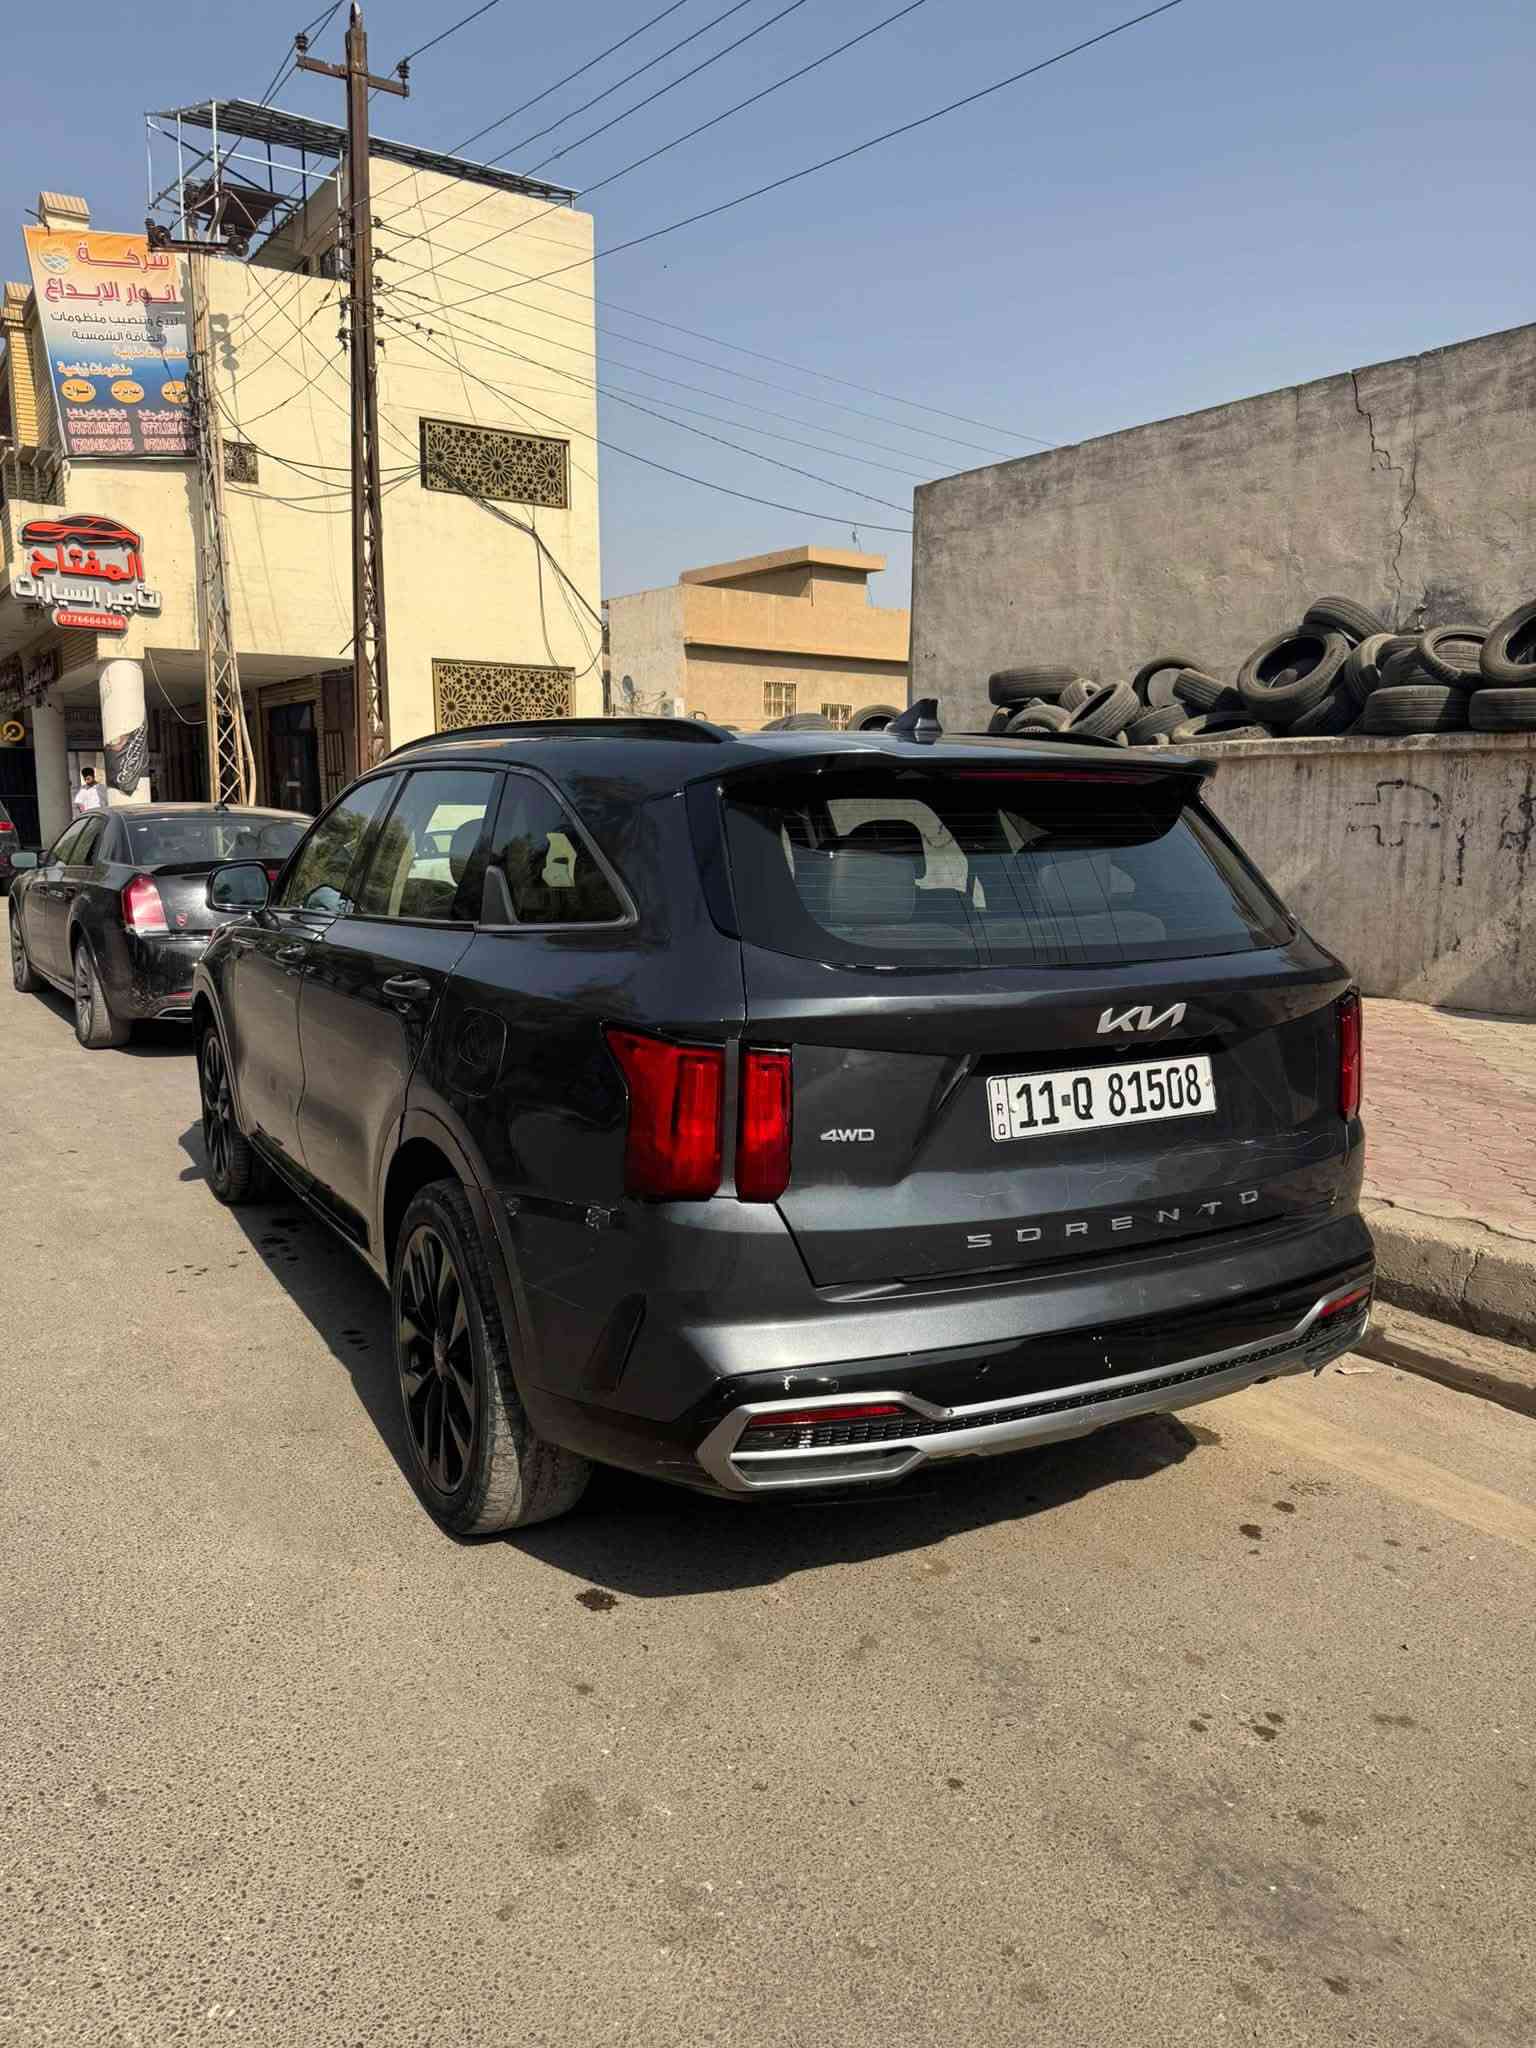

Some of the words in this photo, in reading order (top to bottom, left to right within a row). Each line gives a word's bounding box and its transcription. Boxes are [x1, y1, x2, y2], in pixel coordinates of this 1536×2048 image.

[31, 543, 145, 583] المفتاح
[16, 575, 100, 608] السيارات
[1107, 1063, 1201, 1118] 81508
[820, 1128, 875, 1143] 4WD
[966, 1190, 1259, 1250] SORENTO
